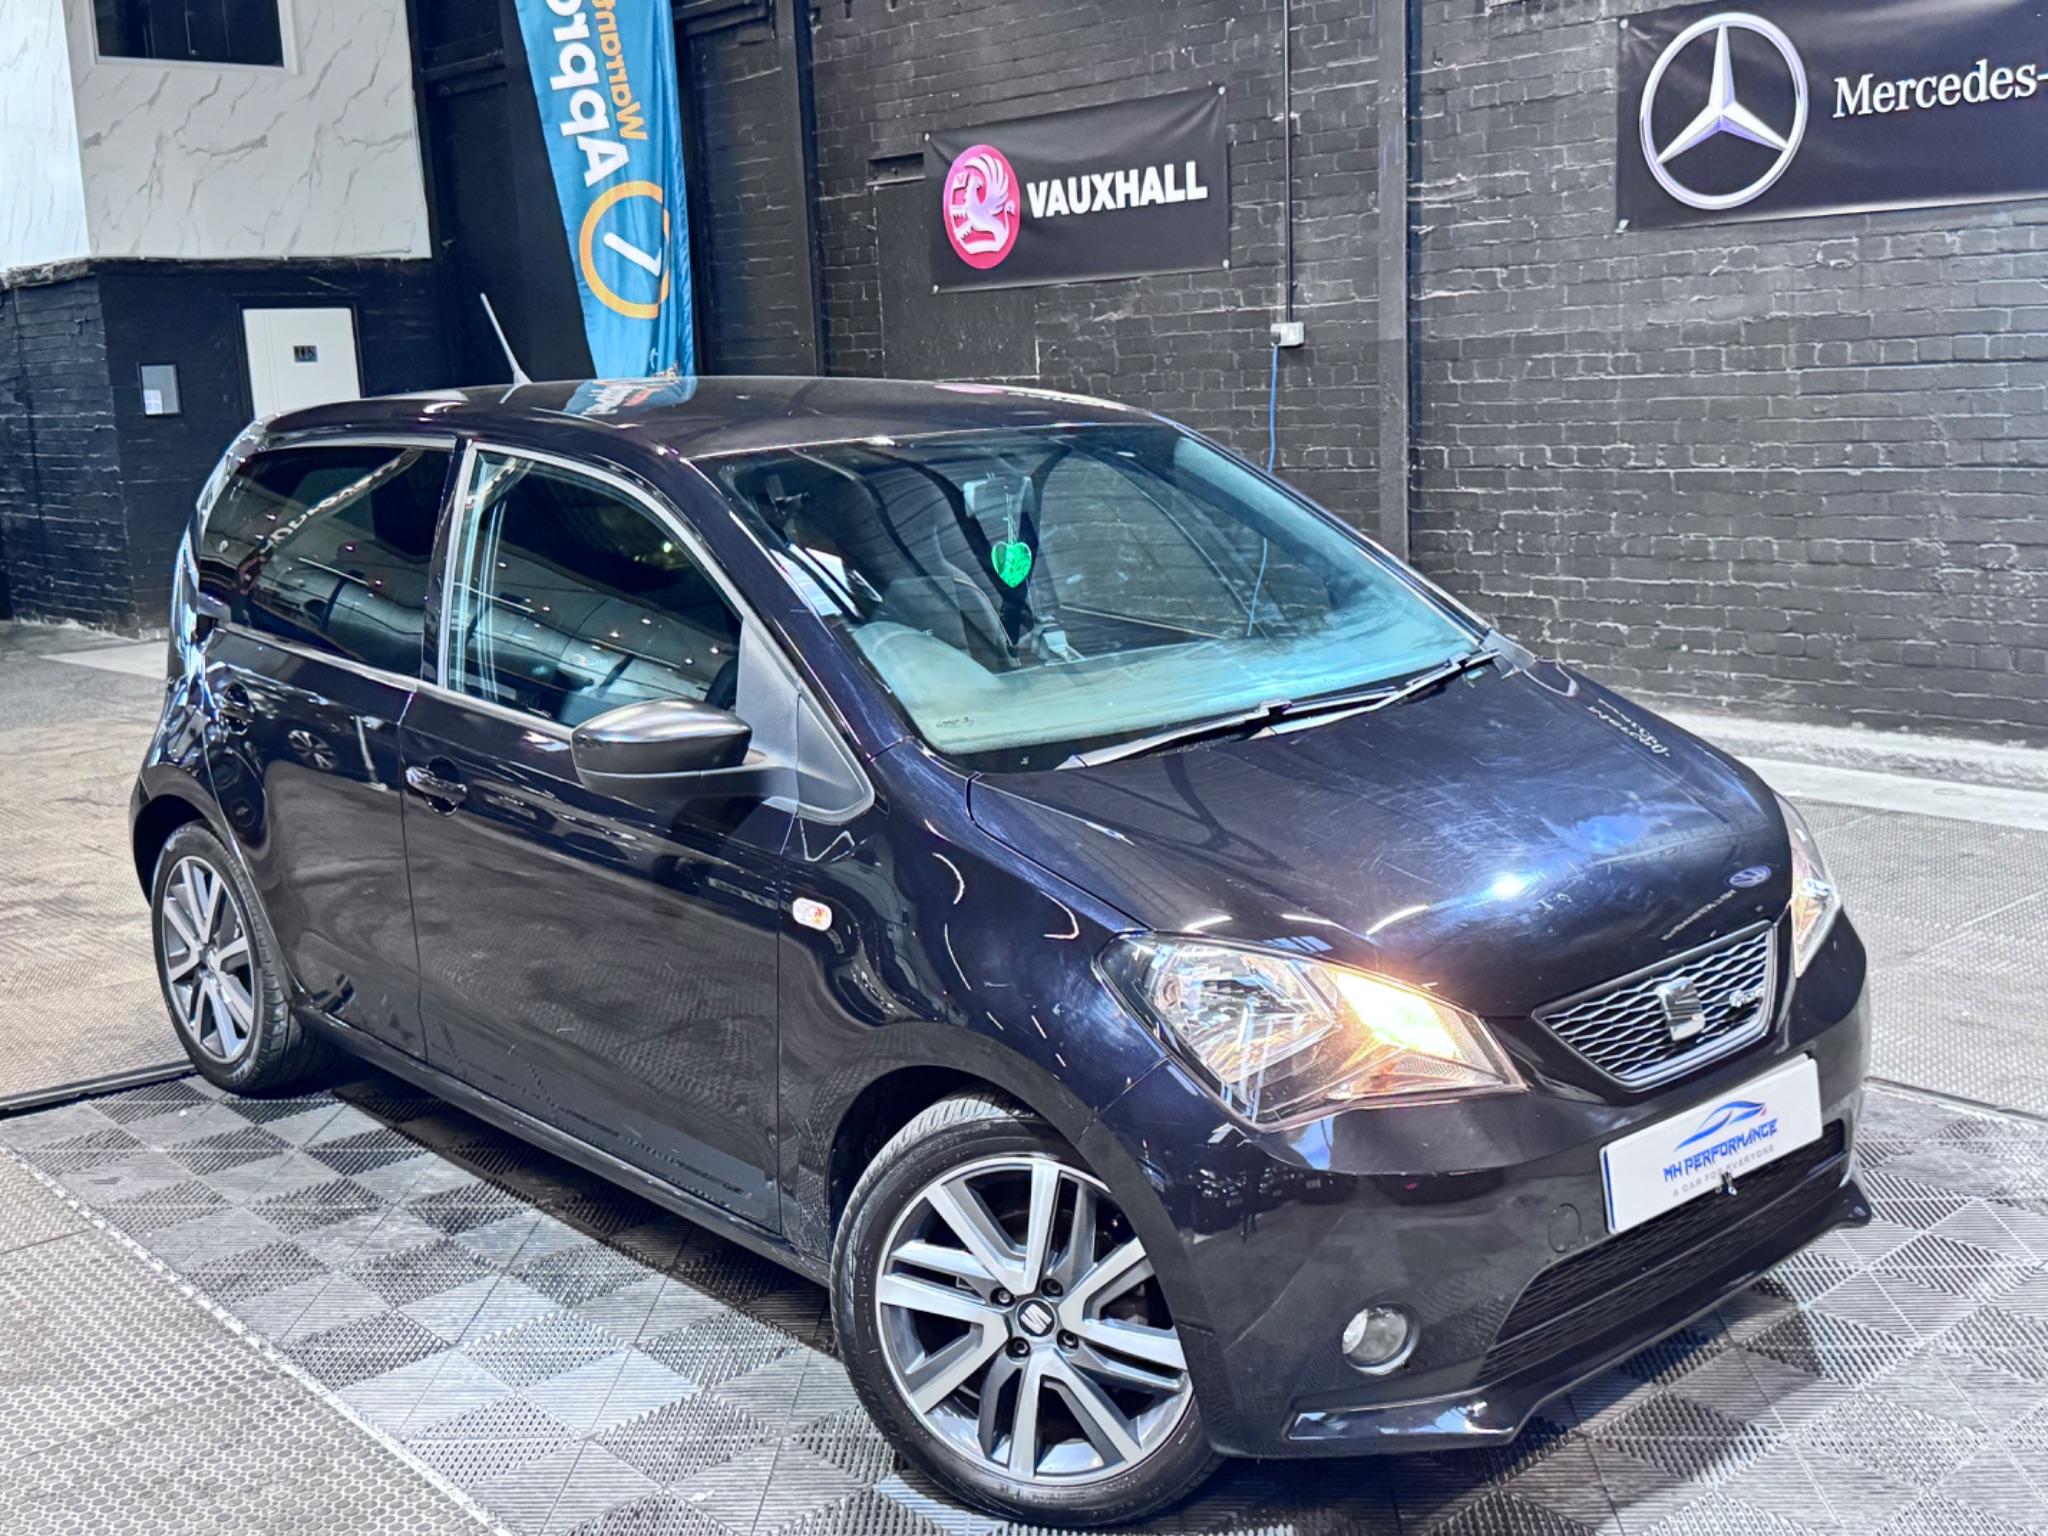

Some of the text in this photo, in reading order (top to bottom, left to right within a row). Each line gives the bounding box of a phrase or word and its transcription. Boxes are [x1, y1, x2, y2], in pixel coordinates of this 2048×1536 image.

[1026, 160, 1208, 218] VAUXHALL
[1663, 1118, 1778, 1182] MH PERFORMANCE
[1682, 1177, 1702, 1193] CAR
[1726, 1144, 1775, 1171] EVERYONE
